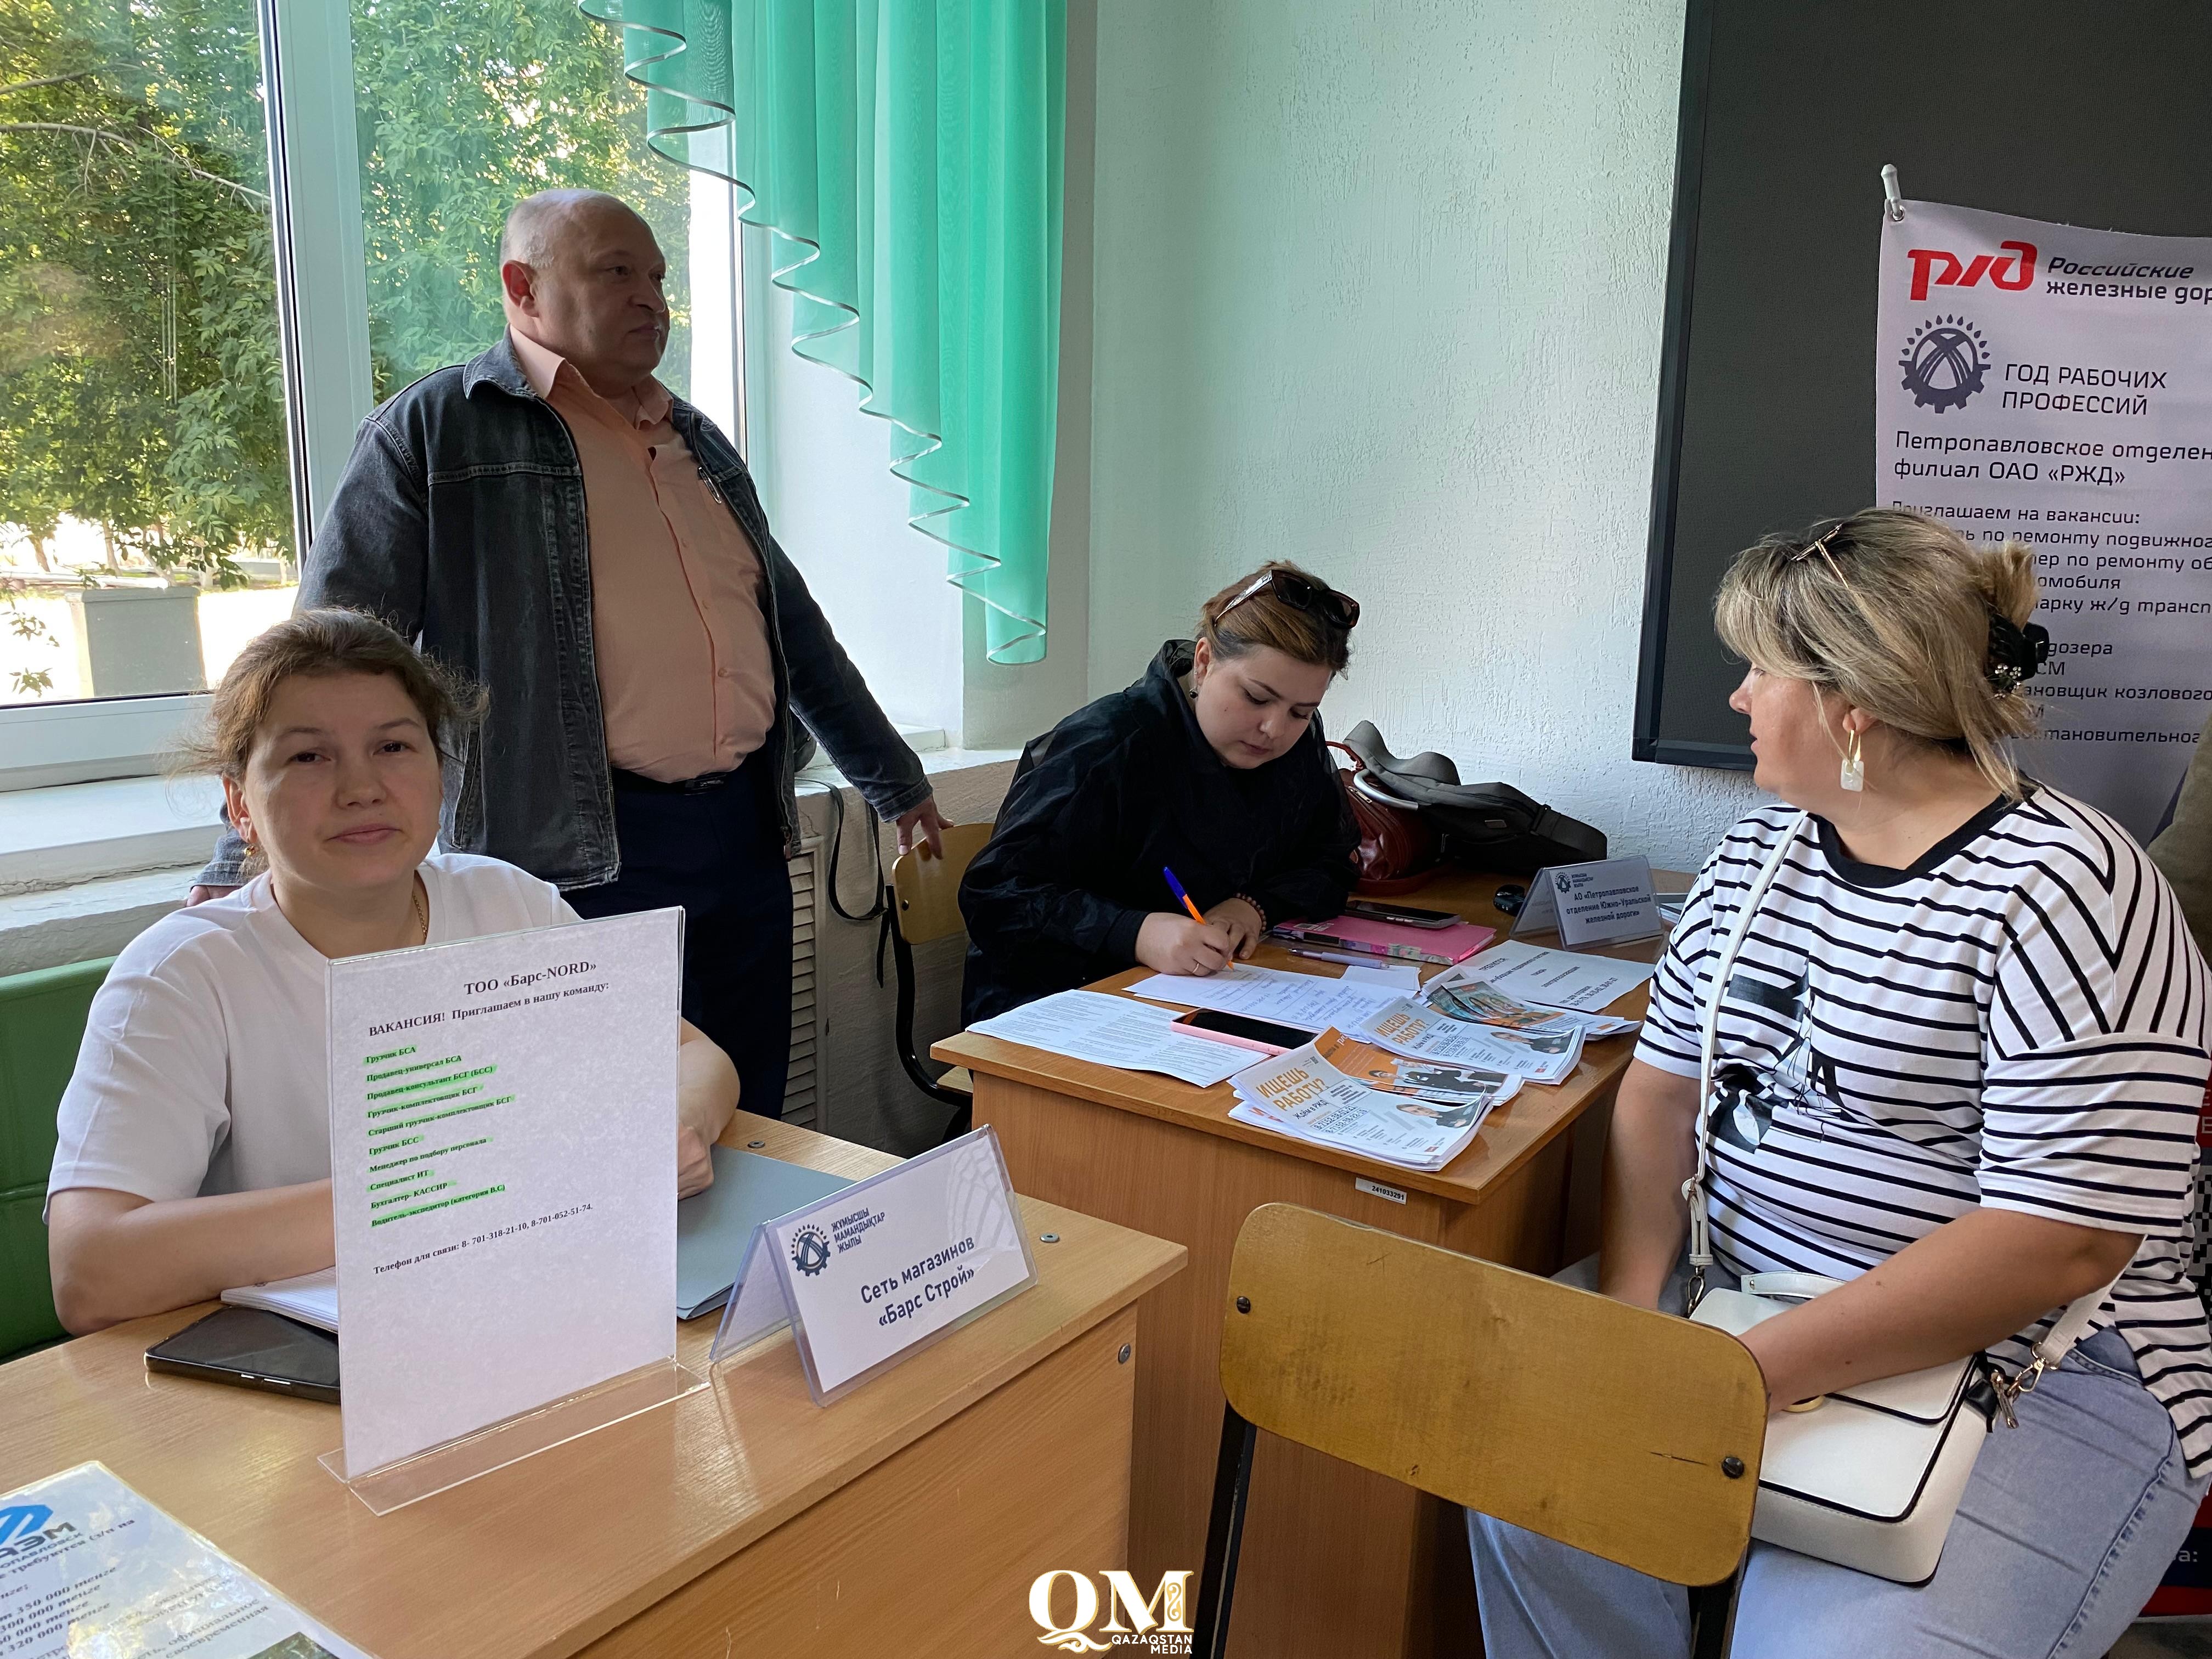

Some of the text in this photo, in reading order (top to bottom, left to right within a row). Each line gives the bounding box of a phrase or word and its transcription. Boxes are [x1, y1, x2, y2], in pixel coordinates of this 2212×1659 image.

[2047, 257, 2194, 279] Российские
[2047, 281, 2167, 300] железные
[2005, 364, 2168, 389] ГОД РАБОЧИХ
[2002, 391, 2148, 416] ПРОФЕССИЙ
[1896, 431, 2212, 463] Петропавловское отделен
[1894, 458, 2126, 487] филиал ОАО «РЖД»
[2018, 510, 2039, 520] на
[2046, 510, 2140, 524] вакансии:
[1983, 531, 2004, 541] по
[2012, 531, 2099, 548] ремонту
[2107, 535, 2212, 549] подвижног
[2067, 555, 2089, 566] по
[2096, 556, 2185, 573] ремонту
[2038, 575, 2120, 589] омобиля
[2090, 597, 2130, 615] ж/д
[2138, 601, 2211, 616] трансп
[2047, 643, 2113, 658] дозера
[2024, 686, 2212, 701] ановщик козлового
[464, 961, 597, 995] ТОО «Барс-NORD»
[369, 1012, 445, 1037] ВАКАНСИЯ!
[452, 998, 522, 1021] Приглашаем
[533, 992, 561, 1004] нашу
[563, 983, 610, 998] команду:
[1374, 1013, 1412, 1037] ИЩЕШЬ
[1391, 1018, 1429, 1045] РАБОТУ?
[366, 1046, 416, 1064] Грузчик БСА
[366, 1055, 462, 1082] Продавец-универсал БСА
[367, 1076, 452, 1100] Продавец-консультант
[1256, 1068, 1310, 1098] ИЩЕШЬ
[1273, 1078, 1330, 1111] РАБОТУ?
[368, 1092, 461, 1119] Грузчик-комплектовщик
[368, 1122, 404, 1136] Старший
[369, 1136, 420, 1155] Грузчик БСС
[370, 1158, 408, 1173] Менеджер
[420, 1148, 449, 1160] подбору
[450, 1138, 487, 1152] персонала
[370, 1174, 415, 1191] Специалист
[414, 1182, 448, 1197] КАССИР
[831, 1207, 870, 1232] ЖҰМЫСШЫ
[834, 1212, 885, 1243] МАМАНДЫҚТАР
[837, 1234, 862, 1254] ЖЫЛЫ
[374, 1257, 413, 1274] Телефон
[414, 1252, 431, 1265] для
[432, 1244, 460, 1257] связи:
[861, 1237, 975, 1305] Сеть магазинов
[878, 1267, 975, 1328] «Барс Строй»
[46, 1587, 71, 1601] 000
[29, 1605, 54, 1620] 000
